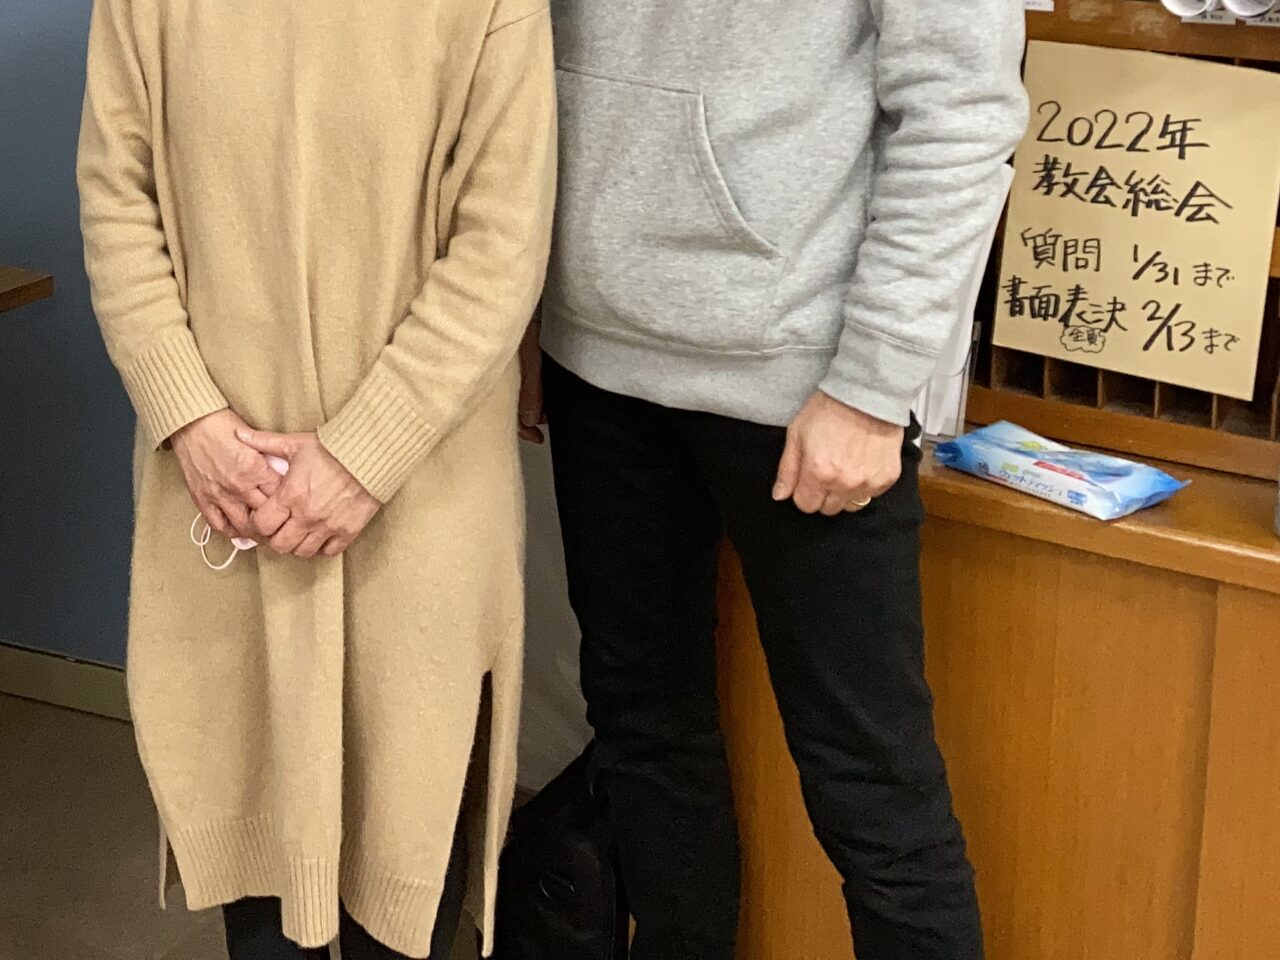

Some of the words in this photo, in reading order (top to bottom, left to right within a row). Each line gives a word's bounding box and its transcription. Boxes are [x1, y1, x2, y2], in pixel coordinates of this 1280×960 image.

[1036, 100, 1210, 160] 2022年
[1032, 153, 1234, 225] 教会総会
[1020, 227, 1101, 273] 質問
[1132, 243, 1180, 286] 1/31
[1192, 261, 1235, 289] まで
[1001, 274, 1128, 333] 書面表決
[1141, 299, 1196, 352] 2/13
[1201, 327, 1241, 355] まで
